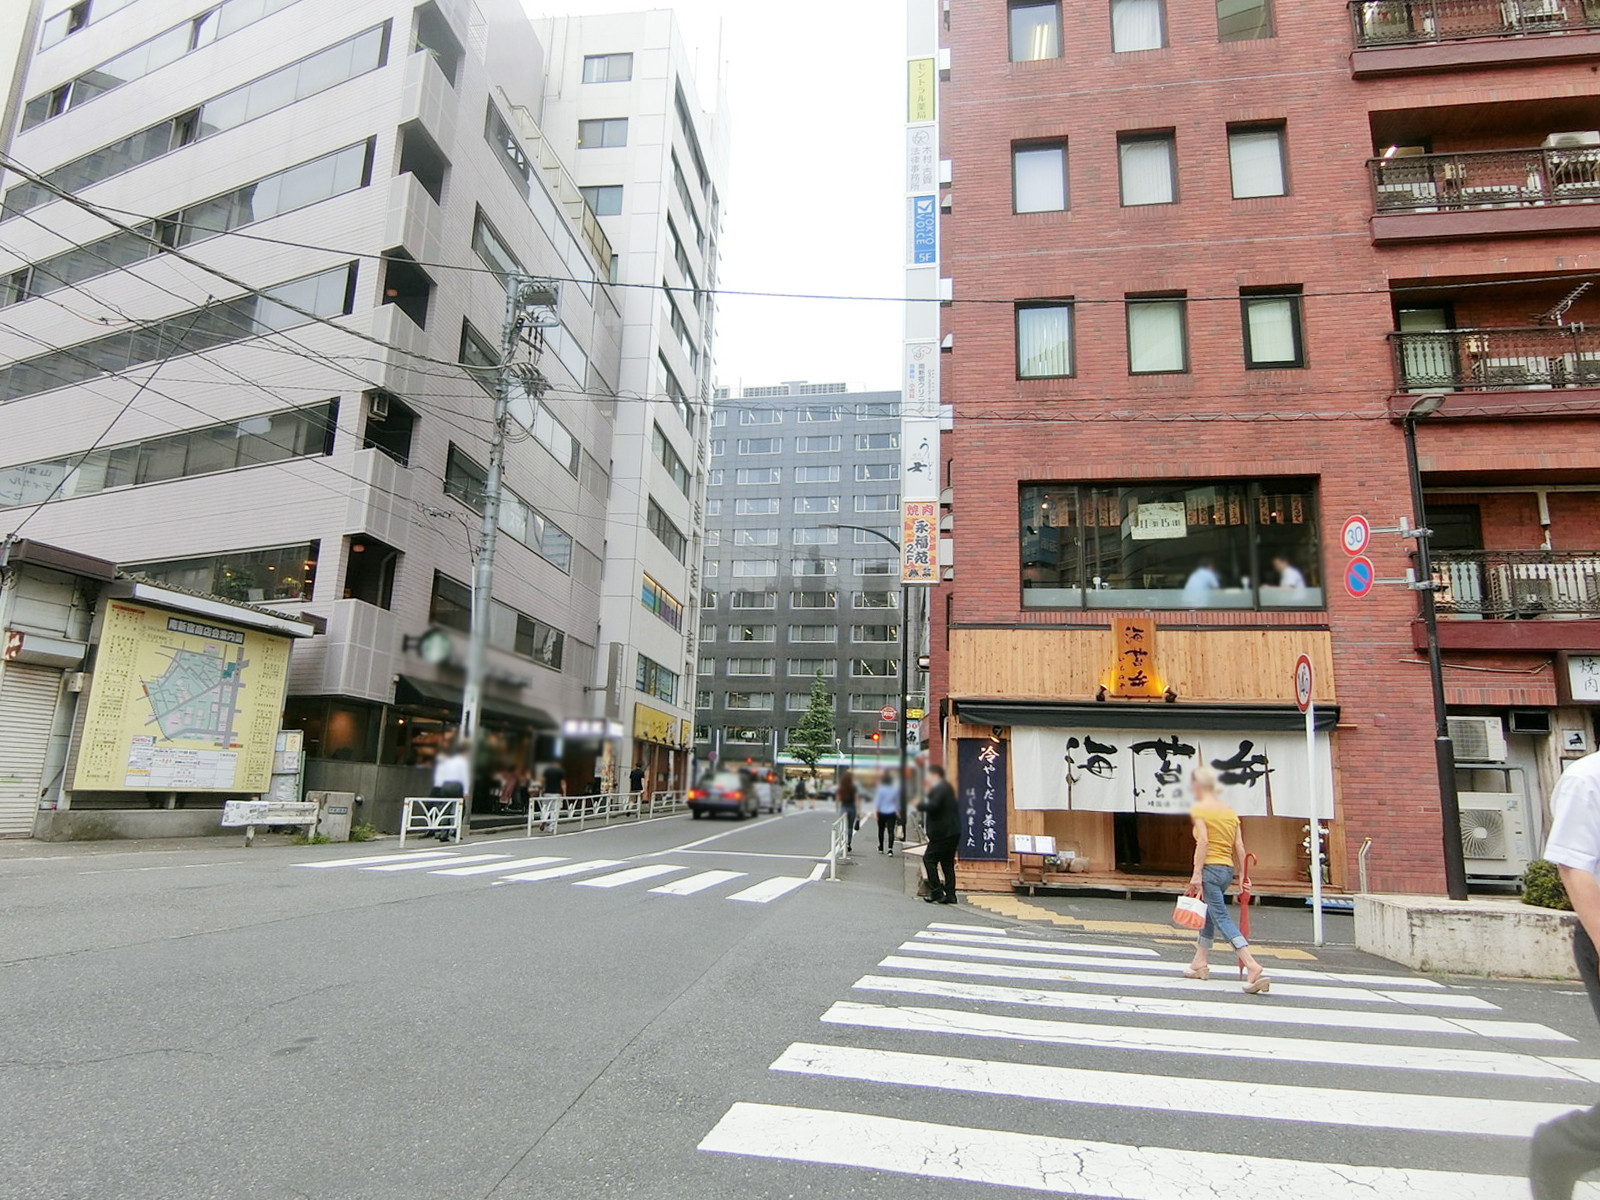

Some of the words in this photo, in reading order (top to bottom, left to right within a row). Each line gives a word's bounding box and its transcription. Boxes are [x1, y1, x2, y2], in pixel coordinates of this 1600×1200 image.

[916, 213, 925, 245] VOICE
[925, 213, 935, 245] TOKYO
[918, 252, 933, 262] 5F
[907, 504, 934, 516] 焼肉
[914, 520, 929, 565] 永福苑
[1347, 526, 1363, 546] 30
[906, 543, 914, 565] 2F
[1124, 626, 1149, 687] 海苔弁
[1579, 658, 1600, 692] 焼肉
[978, 745, 1000, 854] 冷やしだし茶漬け
[966, 788, 977, 847] はじめました
